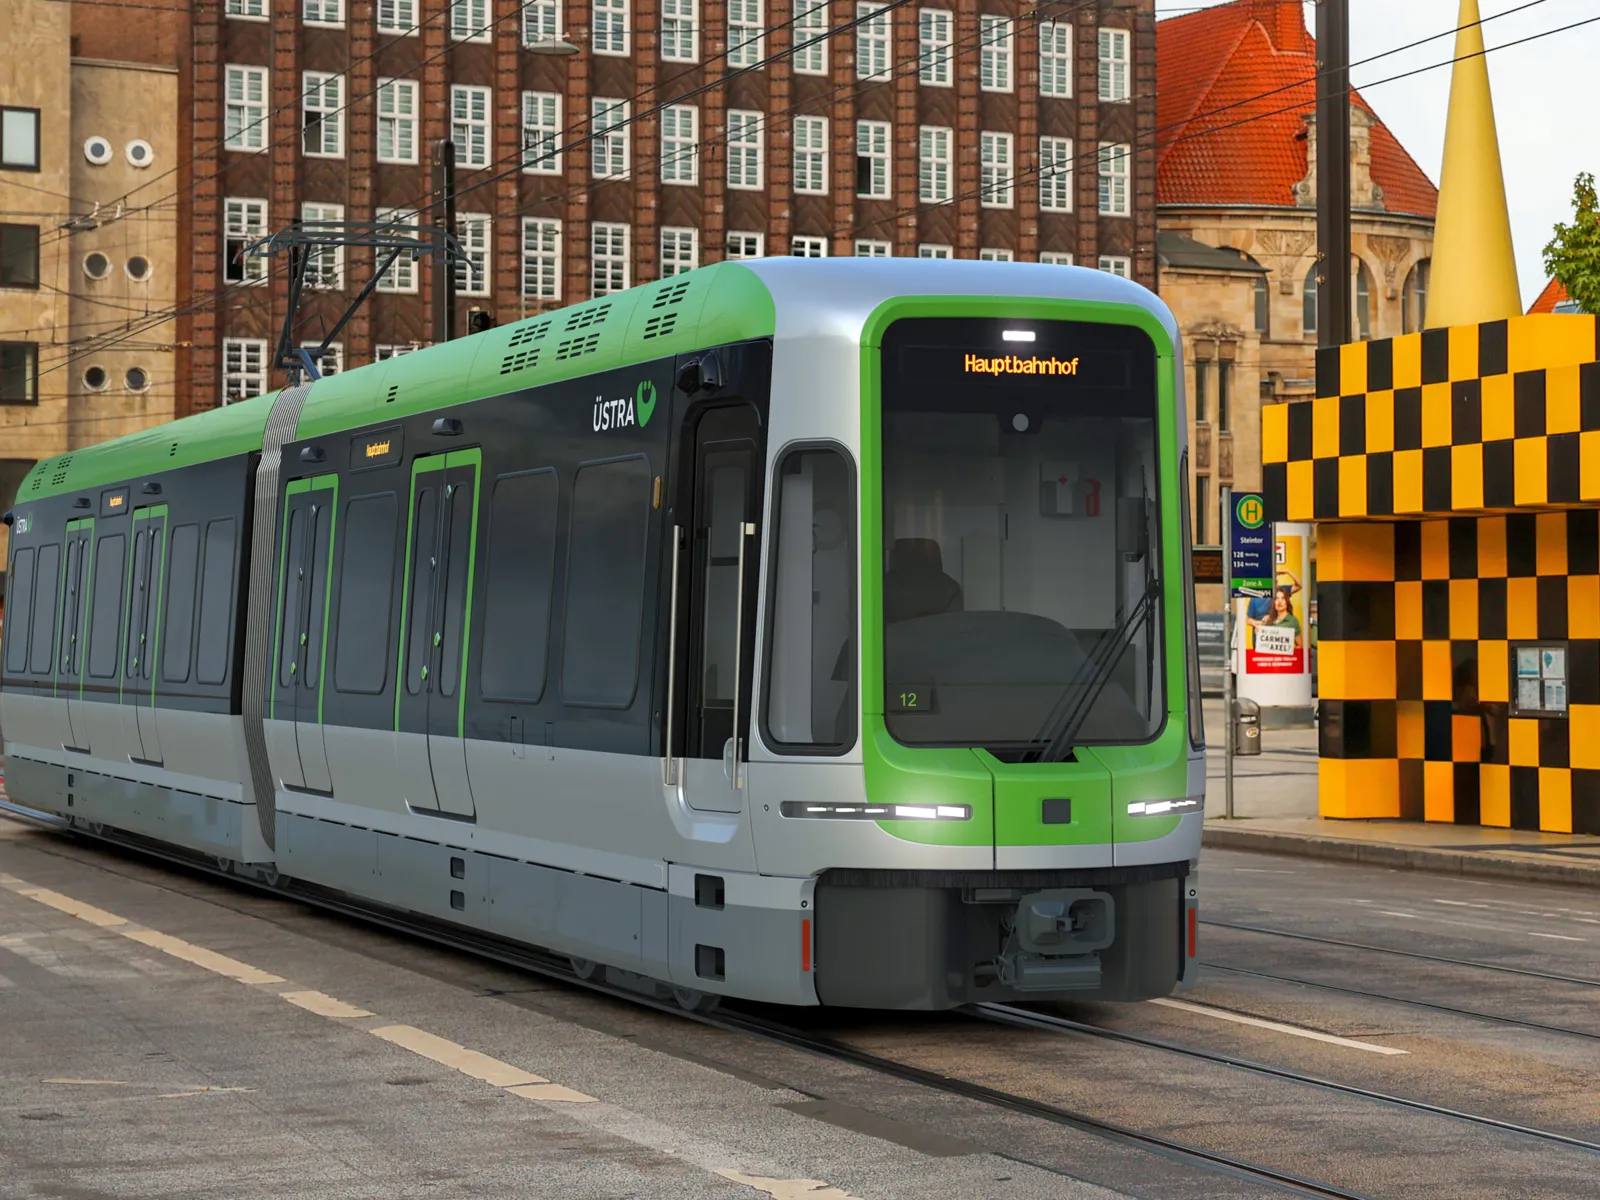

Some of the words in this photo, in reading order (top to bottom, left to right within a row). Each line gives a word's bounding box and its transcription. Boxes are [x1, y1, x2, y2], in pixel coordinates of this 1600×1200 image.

[965, 354, 1079, 376] Hauptbahnhof
[593, 396, 635, 432] ÜSTRA
[1246, 502, 1258, 521] H
[1240, 536, 1263, 544] Steintor
[1260, 635, 1290, 643] CARMEN
[900, 692, 917, 707] 12
